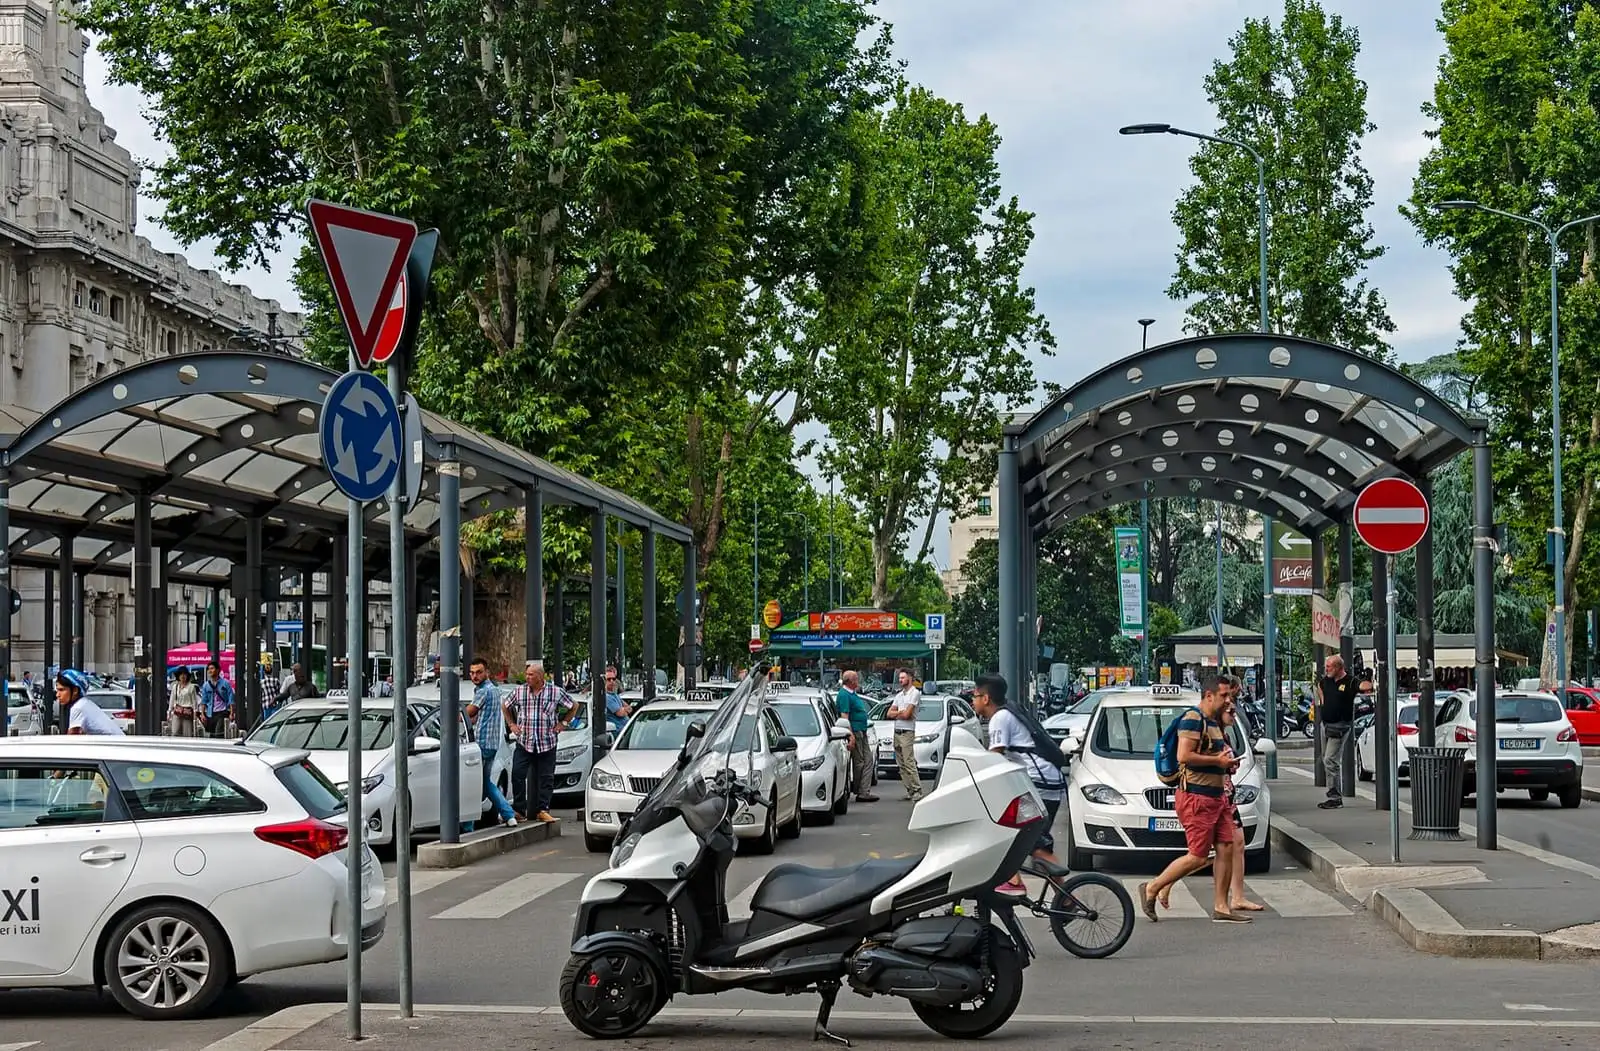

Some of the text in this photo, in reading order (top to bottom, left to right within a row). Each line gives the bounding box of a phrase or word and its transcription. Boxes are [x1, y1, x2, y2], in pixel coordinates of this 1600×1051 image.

[931, 617, 939, 628] P
[1154, 686, 1178, 695] TAXI
[690, 692, 710, 701] TAXI
[13, 925, 17, 935] i
[20, 924, 40, 935] taxi
